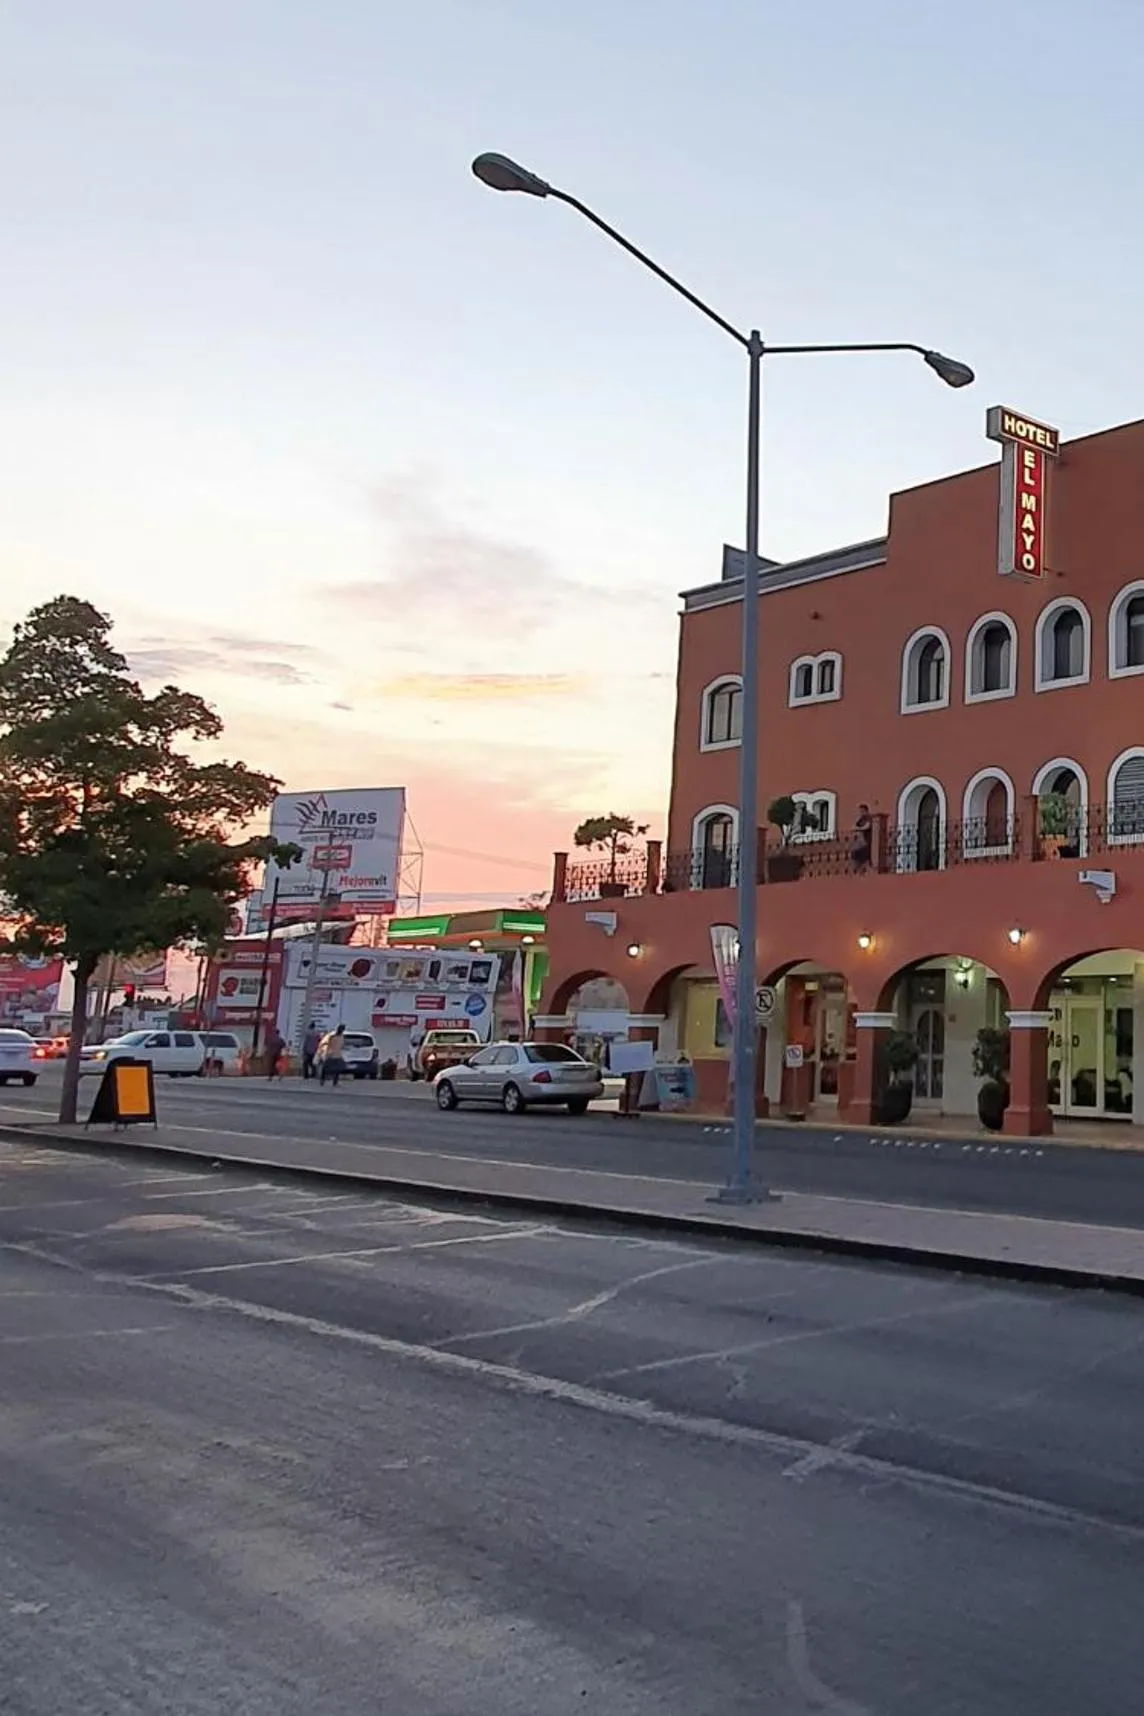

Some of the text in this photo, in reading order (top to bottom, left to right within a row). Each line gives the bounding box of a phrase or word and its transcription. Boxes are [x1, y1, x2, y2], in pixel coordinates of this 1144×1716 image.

[1004, 414, 1055, 449] HOTEL
[1021, 449, 1037, 570] EL MAYO
[320, 809, 378, 826] Mares
